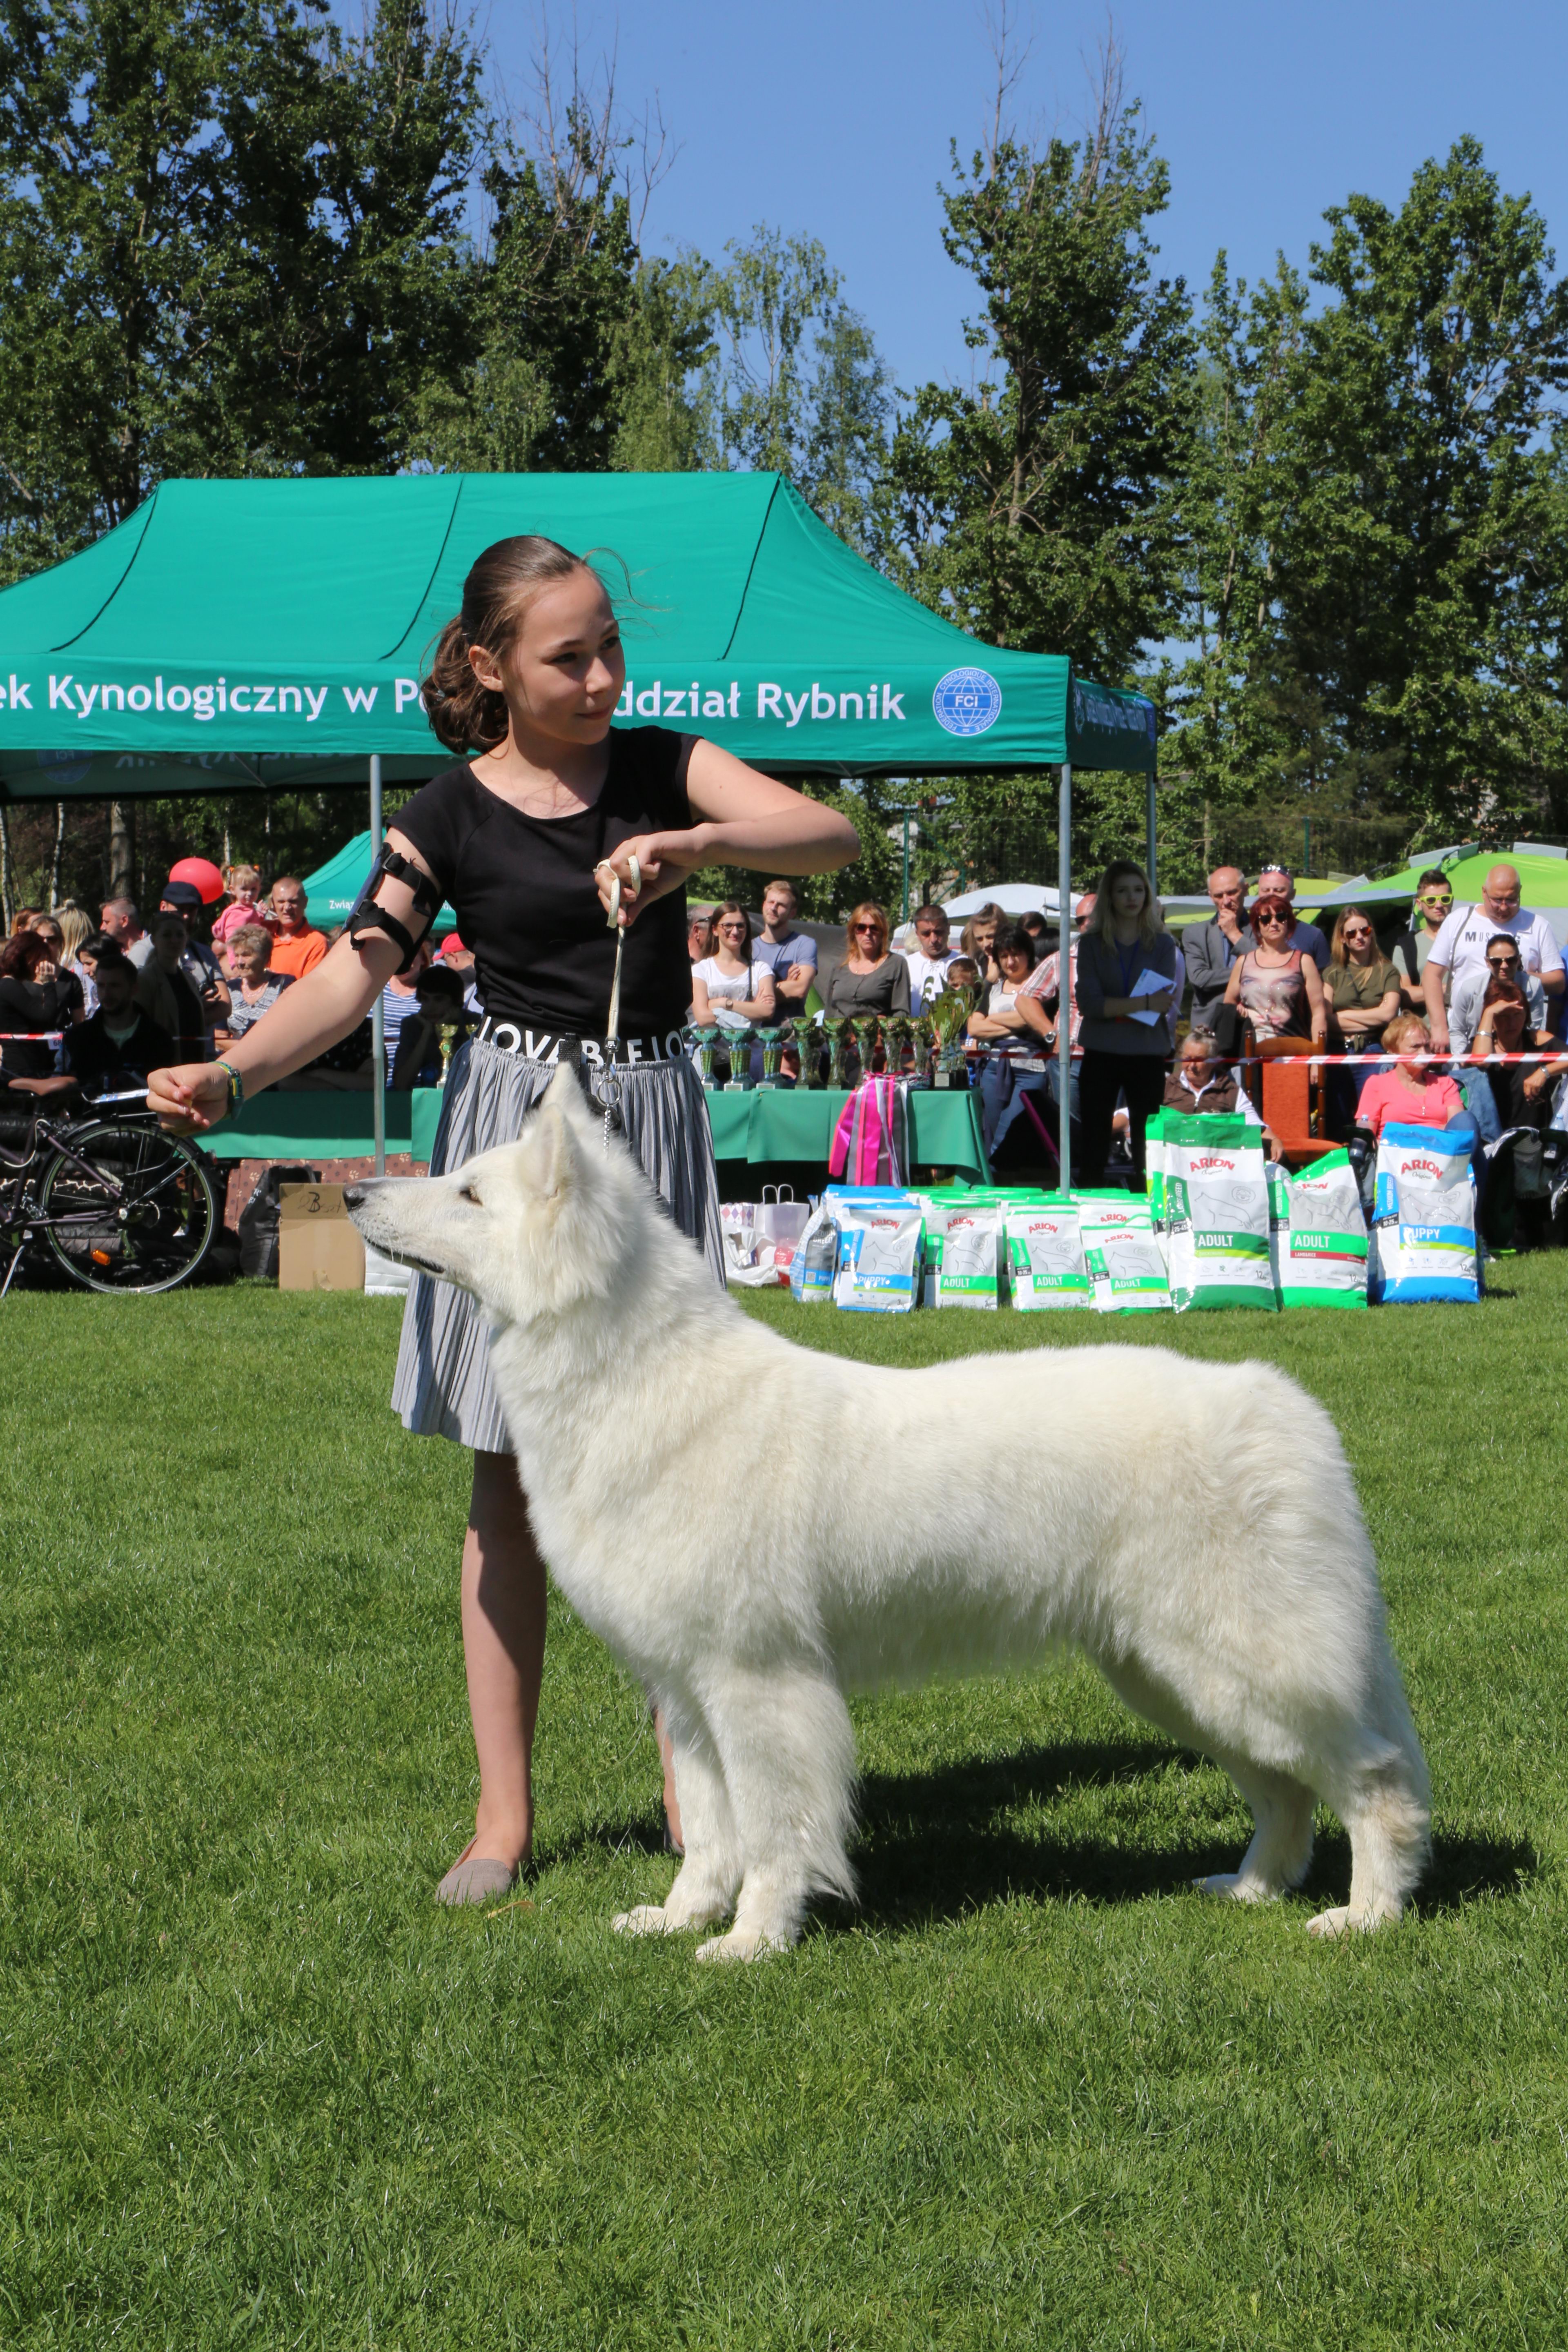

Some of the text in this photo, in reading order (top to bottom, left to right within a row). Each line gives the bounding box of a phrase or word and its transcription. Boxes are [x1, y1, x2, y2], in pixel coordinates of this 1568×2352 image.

[939, 670, 987, 690] CYNOLOGIQUE
[49, 675, 328, 722] Kynologiczny
[342, 687, 379, 713] w
[757, 683, 906, 728] Rybnik
[955, 695, 978, 707] FCI
[974, 679, 999, 732] INTERNATIONALE
[1465, 931, 1521, 945] MUSG
[1189, 1157, 1235, 1172] ARION
[1401, 1159, 1443, 1180] ARION
[871, 1219, 900, 1229] ARION
[947, 1217, 975, 1230] ARION
[1029, 1223, 1058, 1234] ARION
[1105, 1234, 1134, 1243] ARION
[1403, 1227, 1440, 1239] PUPPY
[1198, 1234, 1233, 1247] ADULT
[1294, 1235, 1330, 1248] ADULT
[858, 1276, 886, 1286] PUPPY
[943, 1278, 970, 1287] ADULT
[1037, 1276, 1062, 1286] ADULT
[1115, 1278, 1140, 1289] ADULT
